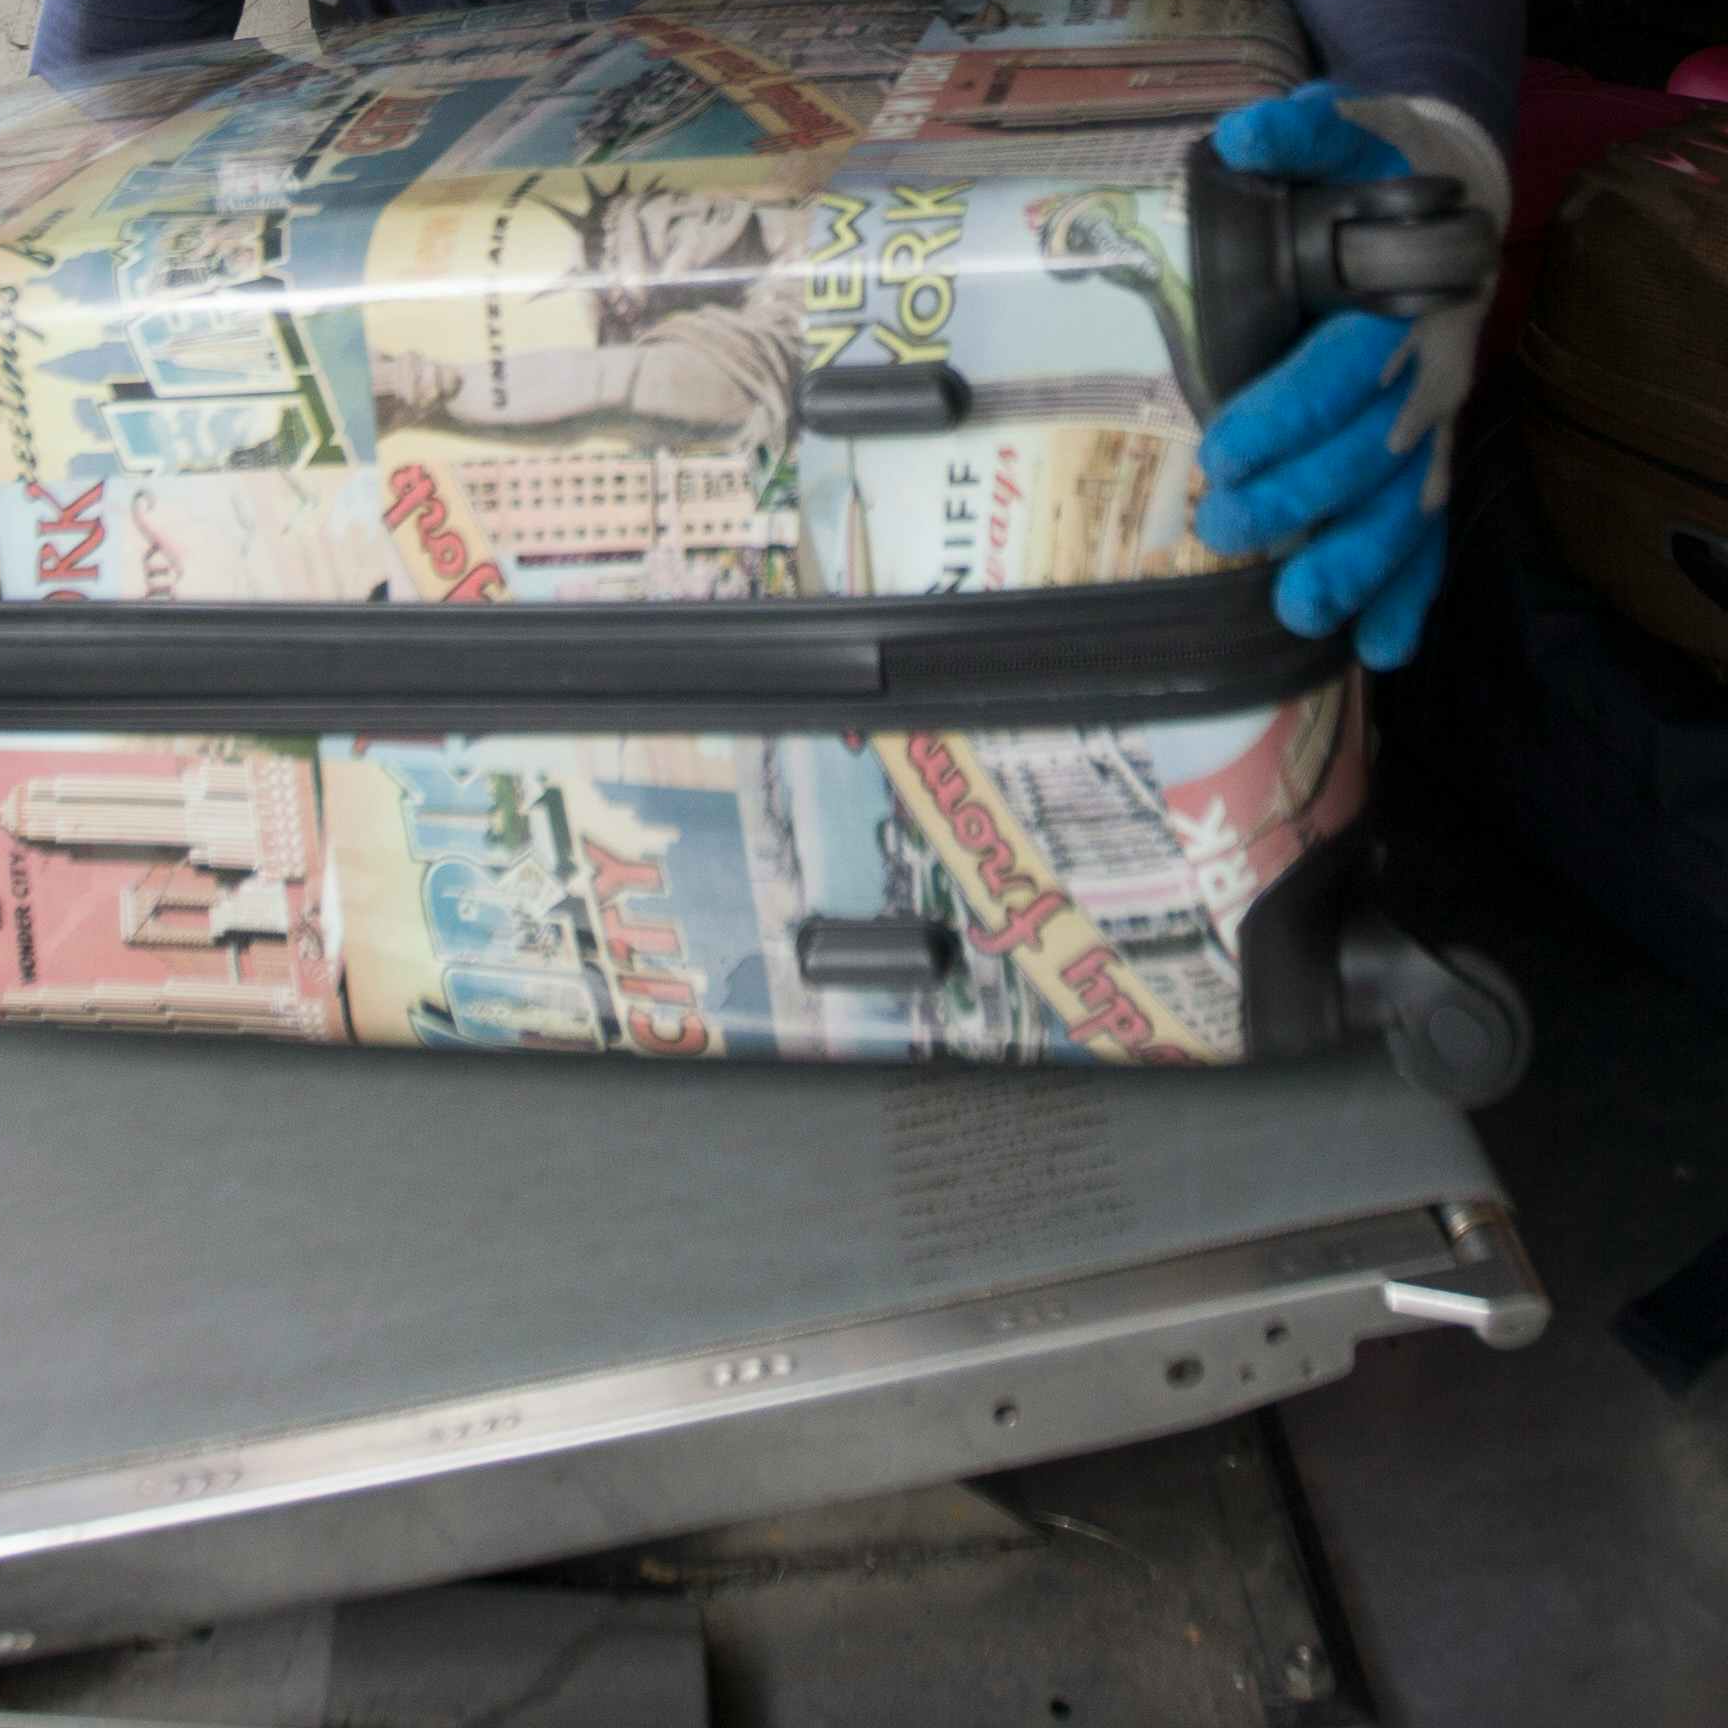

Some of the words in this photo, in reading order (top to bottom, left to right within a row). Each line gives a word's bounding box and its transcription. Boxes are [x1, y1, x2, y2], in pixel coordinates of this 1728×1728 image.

[873, 180, 975, 366] YORK
[27, 479, 108, 601] RK
[580, 834, 710, 1056] CITY
